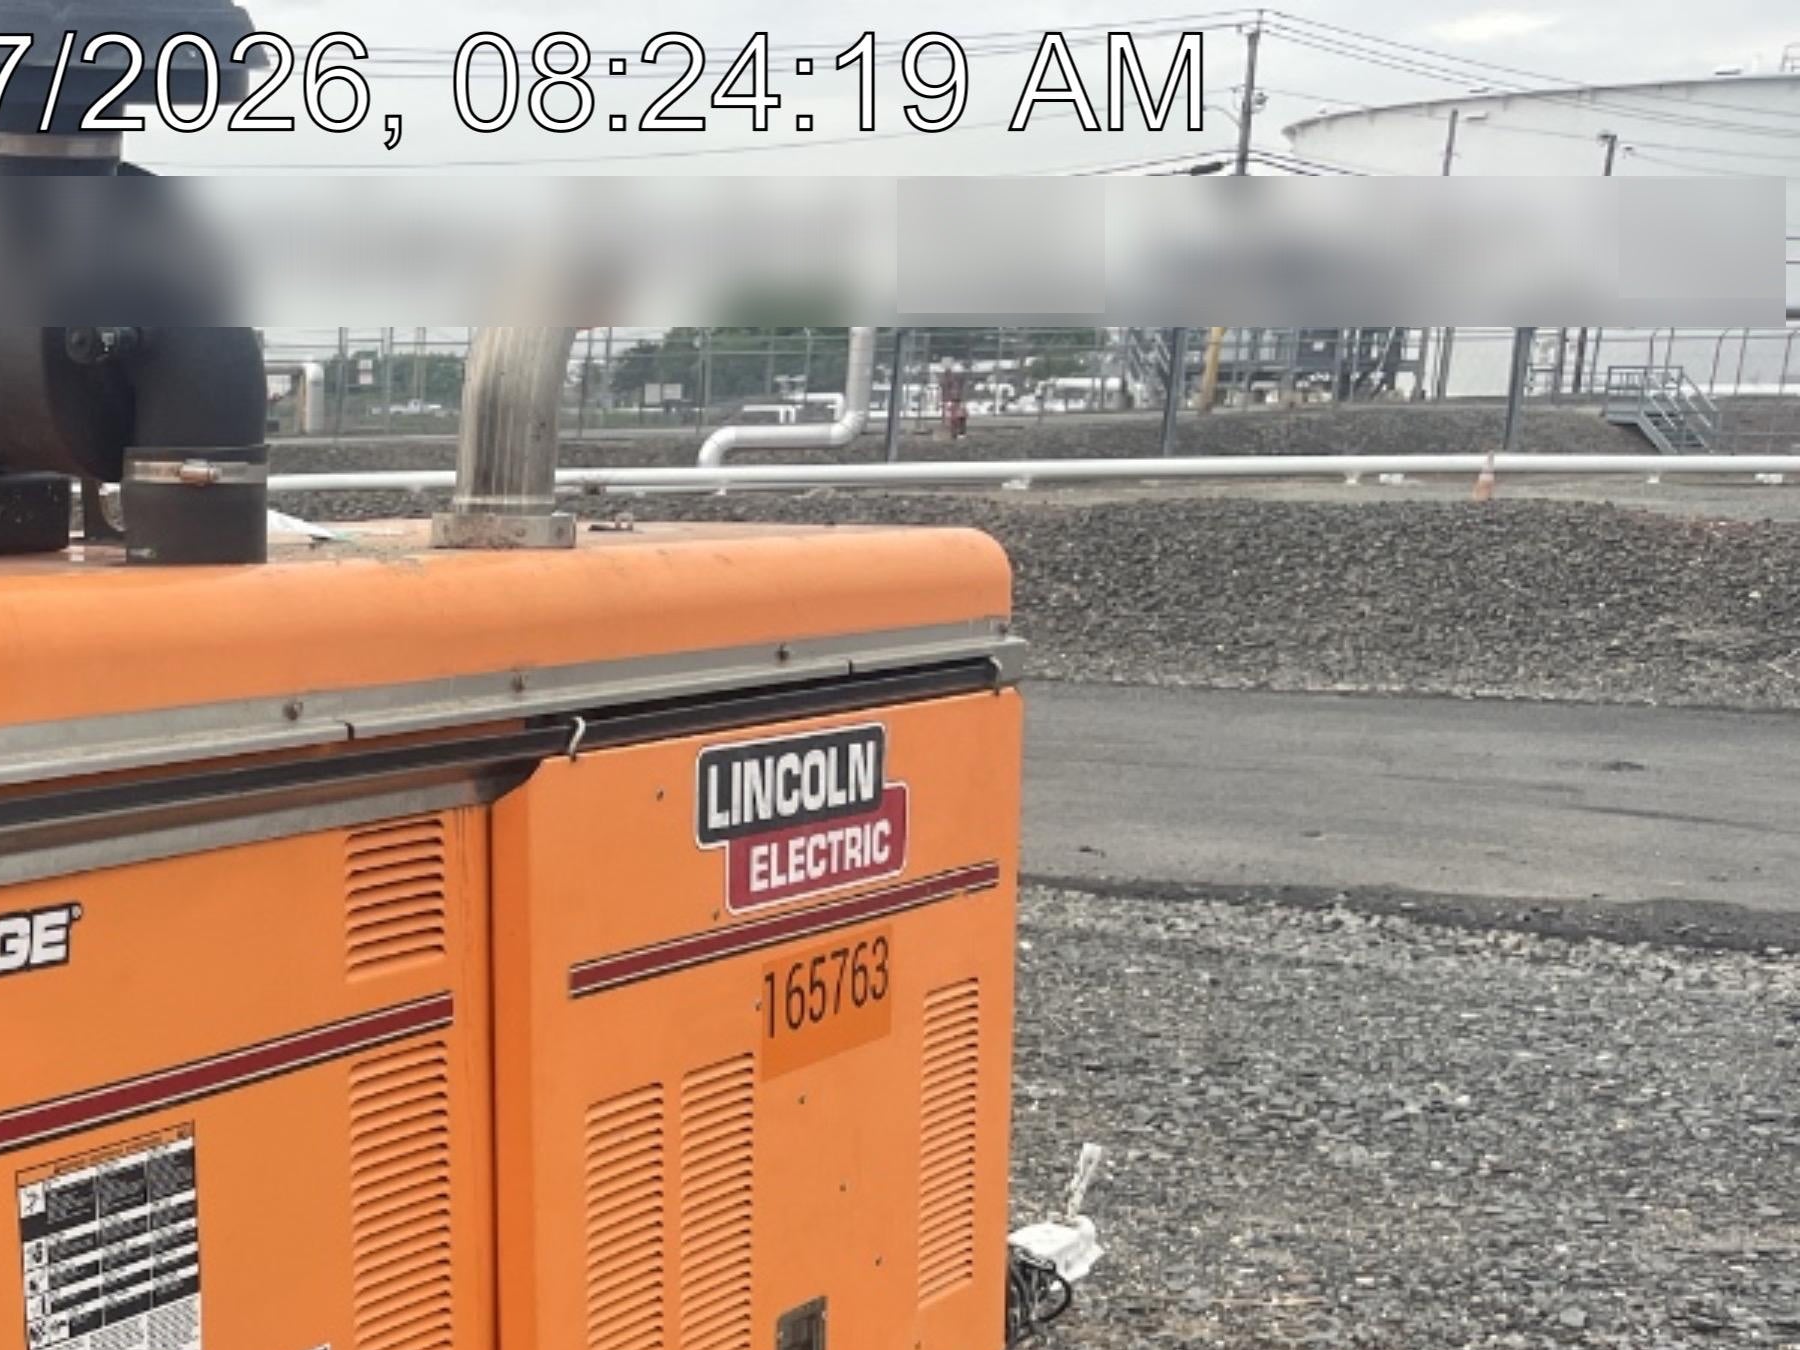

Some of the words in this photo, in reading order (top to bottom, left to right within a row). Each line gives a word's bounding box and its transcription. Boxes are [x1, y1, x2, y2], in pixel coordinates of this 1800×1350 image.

[707, 740, 877, 829] LINCOLN
[750, 818, 892, 892] ELECTRIC
[764, 936, 889, 1039] 165763
